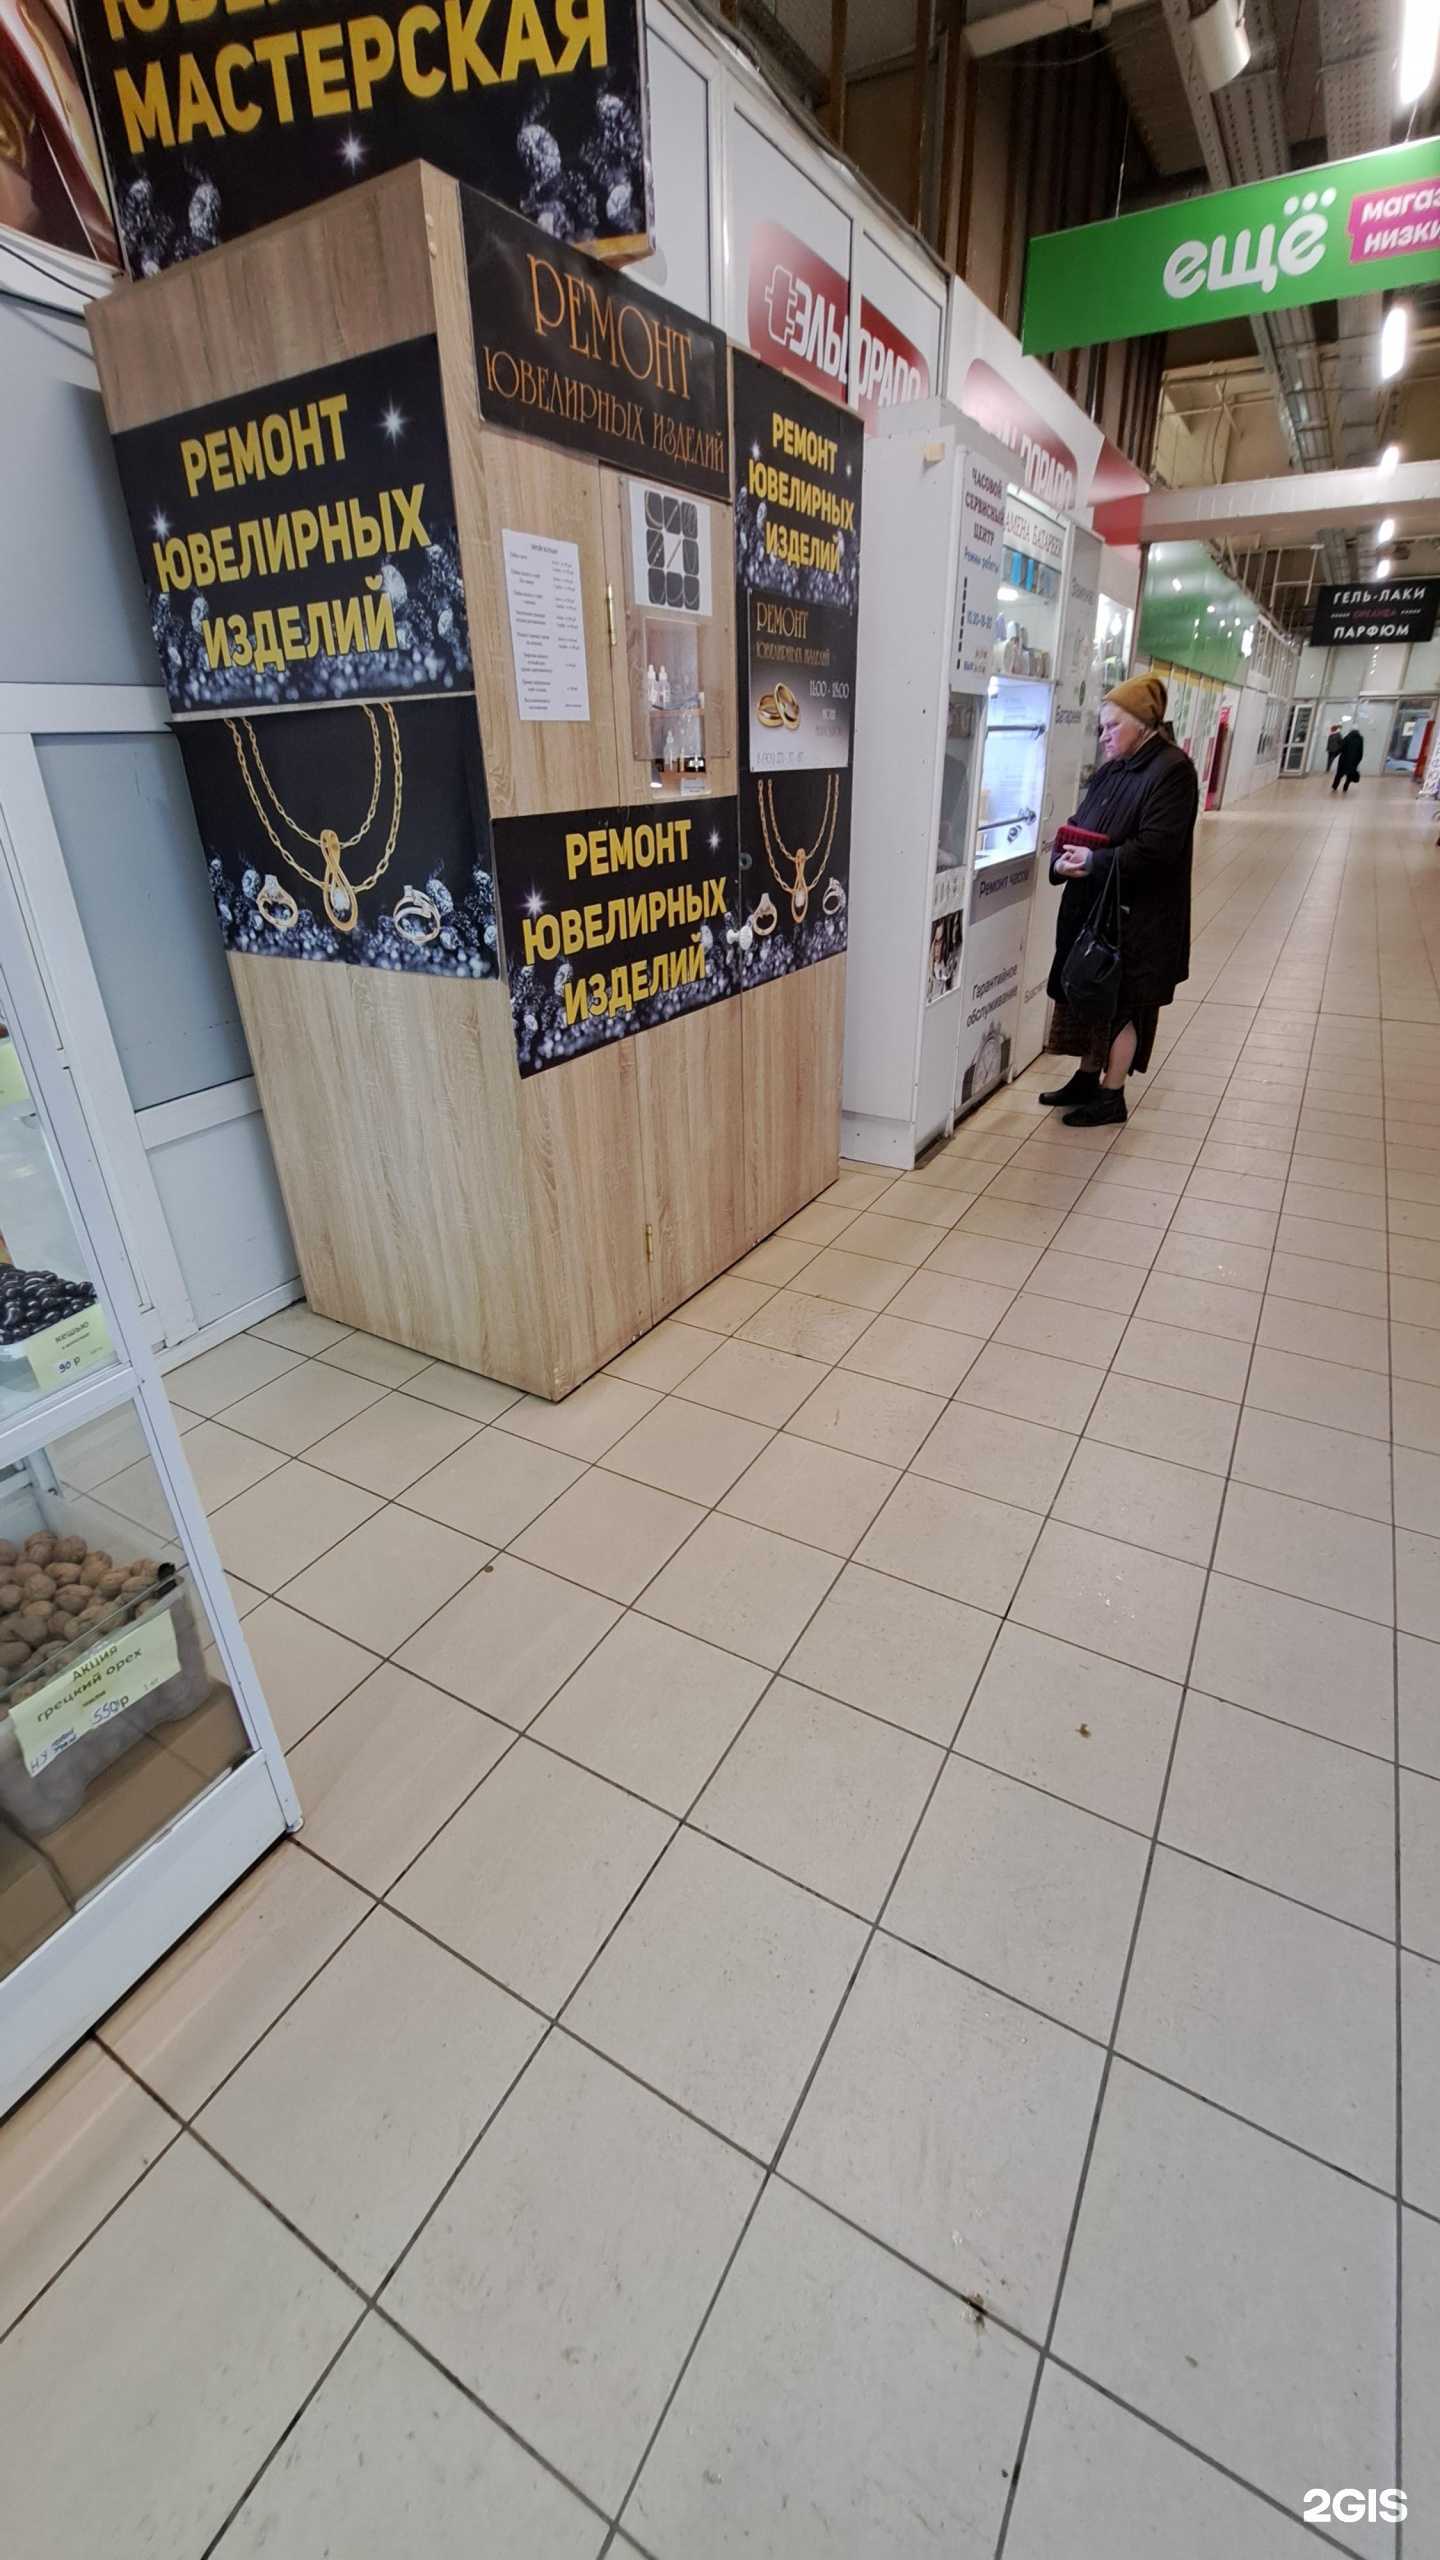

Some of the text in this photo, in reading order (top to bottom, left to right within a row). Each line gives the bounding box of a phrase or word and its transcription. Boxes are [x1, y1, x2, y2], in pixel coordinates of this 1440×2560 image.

[113, 0, 609, 155] МАСТЕРСКАЯ
[1163, 187, 1337, 299] ещё
[527, 253, 693, 400] РЕМОНТ
[180, 394, 348, 497] РЕМОНТ
[483, 344, 725, 474] ЮВЕЛИРНЫХ ИЗДЕЛИЙ
[772, 412, 838, 475] РЕМОНТ
[749, 459, 855, 531] ЮВЕЛИРНЫХ
[153, 483, 432, 593] ЮВЕЛИРНЫХ
[766, 521, 841, 574] ИЗДЕЛИЙ
[203, 575, 397, 673] ИЗДЕЛИЙ
[756, 602, 809, 640] РЕМОНТ
[1333, 587, 1426, 605] ГЕЛЬ-ЛАКИ
[1333, 624, 1410, 640] ПАРФЮМ
[566, 819, 692, 880] РЕМОНТ
[522, 876, 727, 965] ЮВЕЛИРНЫХ
[563, 932, 706, 1025] ИЗДЕЛИЙ
[37, 1673, 102, 1722] грецкий
[106, 1649, 142, 1676] орех
[72, 1645, 118, 1683] АКЦИЯ
